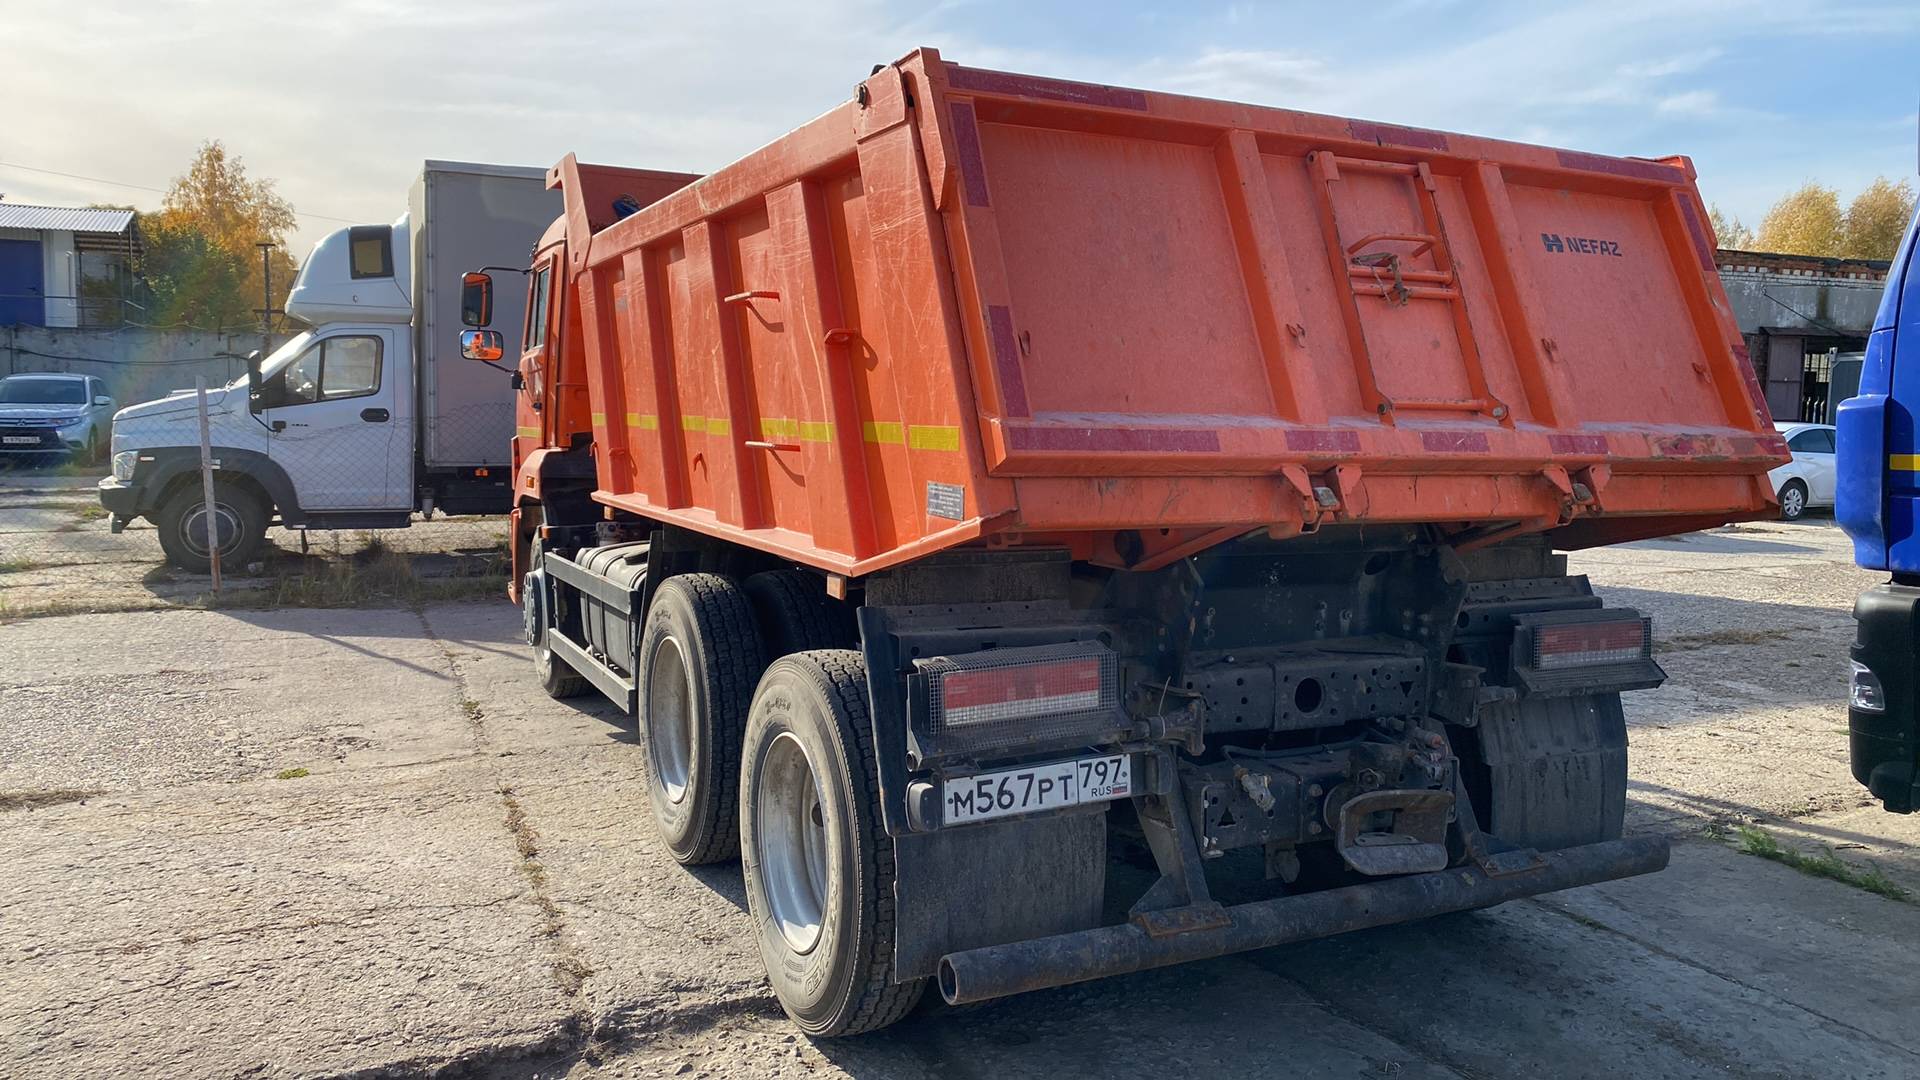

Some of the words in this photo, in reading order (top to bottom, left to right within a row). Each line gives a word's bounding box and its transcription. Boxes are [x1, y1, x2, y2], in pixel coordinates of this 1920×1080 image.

[1565, 237, 1622, 257] NEFAZ
[1079, 758, 1122, 788] 797
[1091, 785, 1112, 797] RUS
